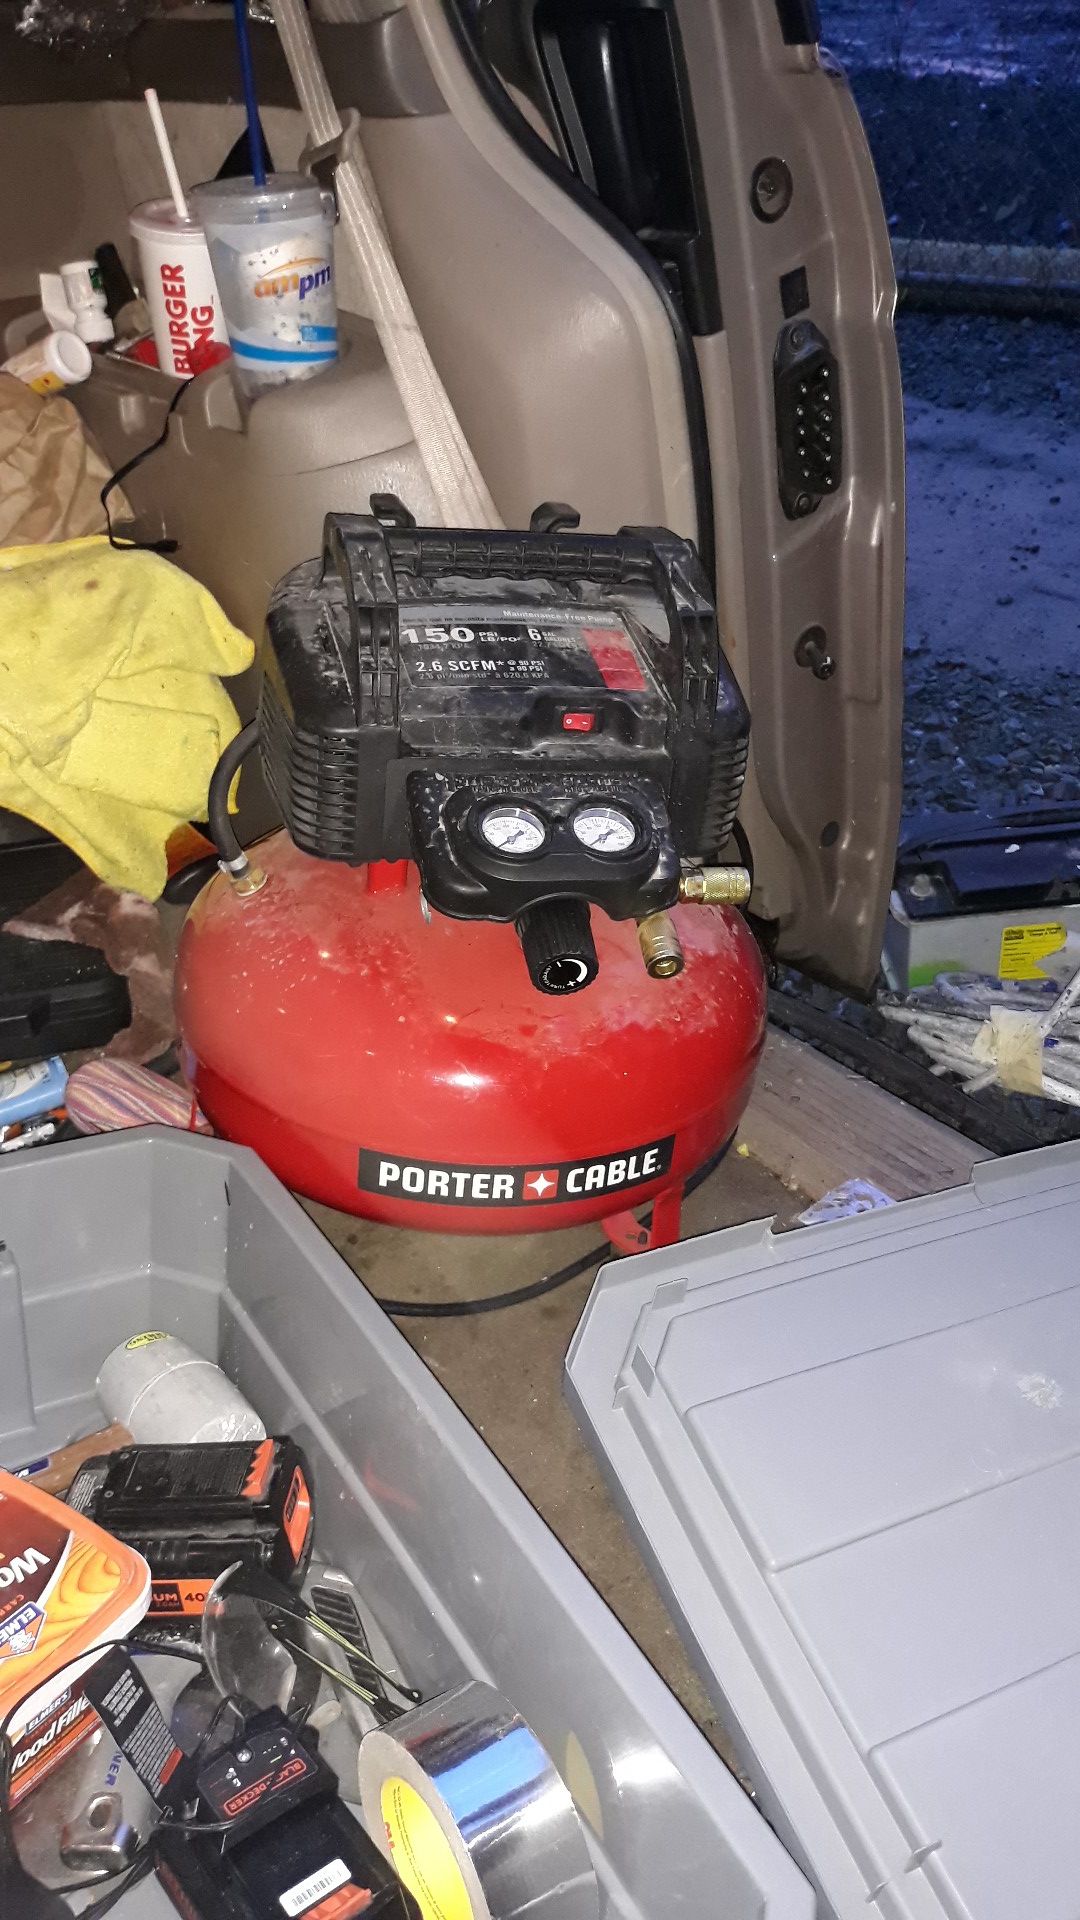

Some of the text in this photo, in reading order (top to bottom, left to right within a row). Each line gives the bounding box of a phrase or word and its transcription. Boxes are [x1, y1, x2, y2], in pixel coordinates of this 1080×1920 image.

[254, 265, 331, 300] ampm
[160, 264, 214, 375] BURGER NG
[401, 627, 475, 644] 150
[527, 628, 542, 641] 6
[415, 661, 443, 672] 2.6
[378, 1147, 659, 1199] PORTER CABLE
[0, 1547, 51, 1589] Wo
[0, 1608, 37, 1645] ELME
[105, 1751, 124, 1786] NER
